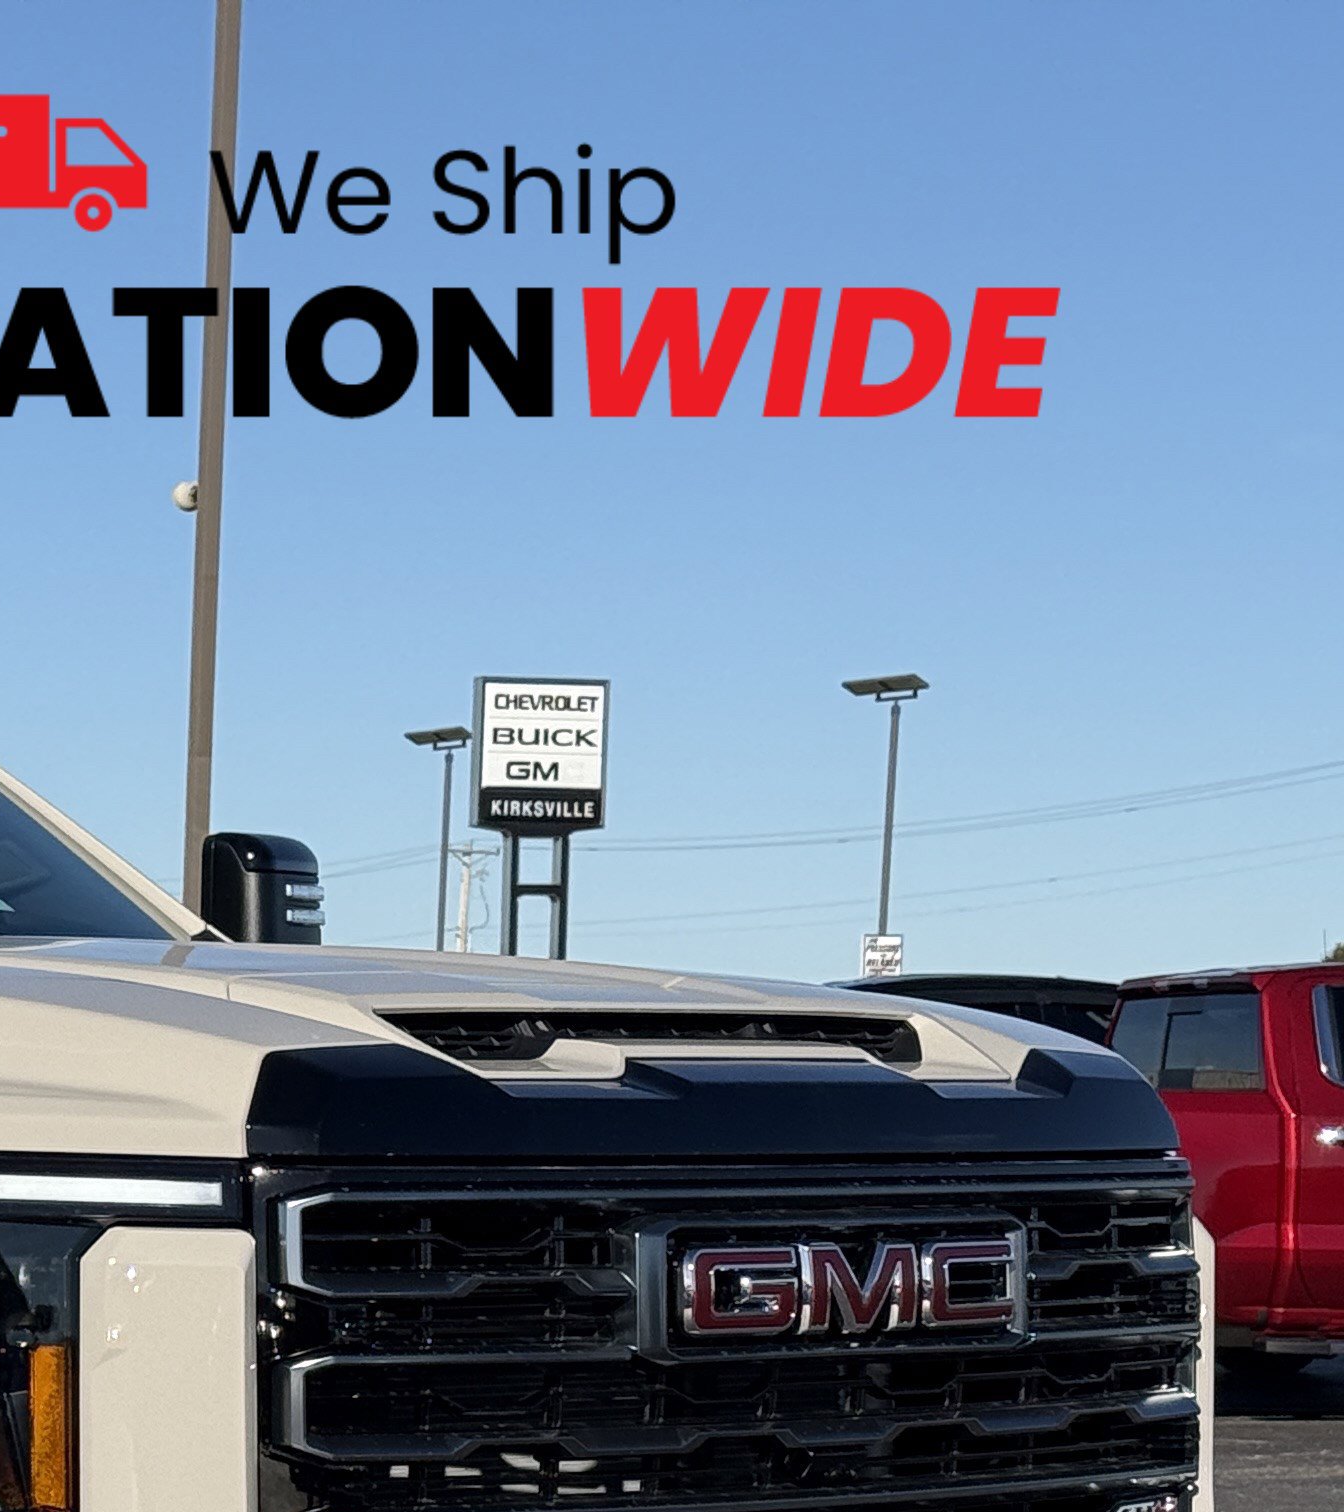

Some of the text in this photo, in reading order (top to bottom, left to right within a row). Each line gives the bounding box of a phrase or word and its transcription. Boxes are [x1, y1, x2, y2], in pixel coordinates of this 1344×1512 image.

[494, 693, 599, 712] CHEVROLET
[492, 727, 598, 748] BUICK
[506, 761, 559, 781] GM
[491, 799, 595, 818] KIRKSVILLE
[682, 1240, 1015, 1334] GMC
